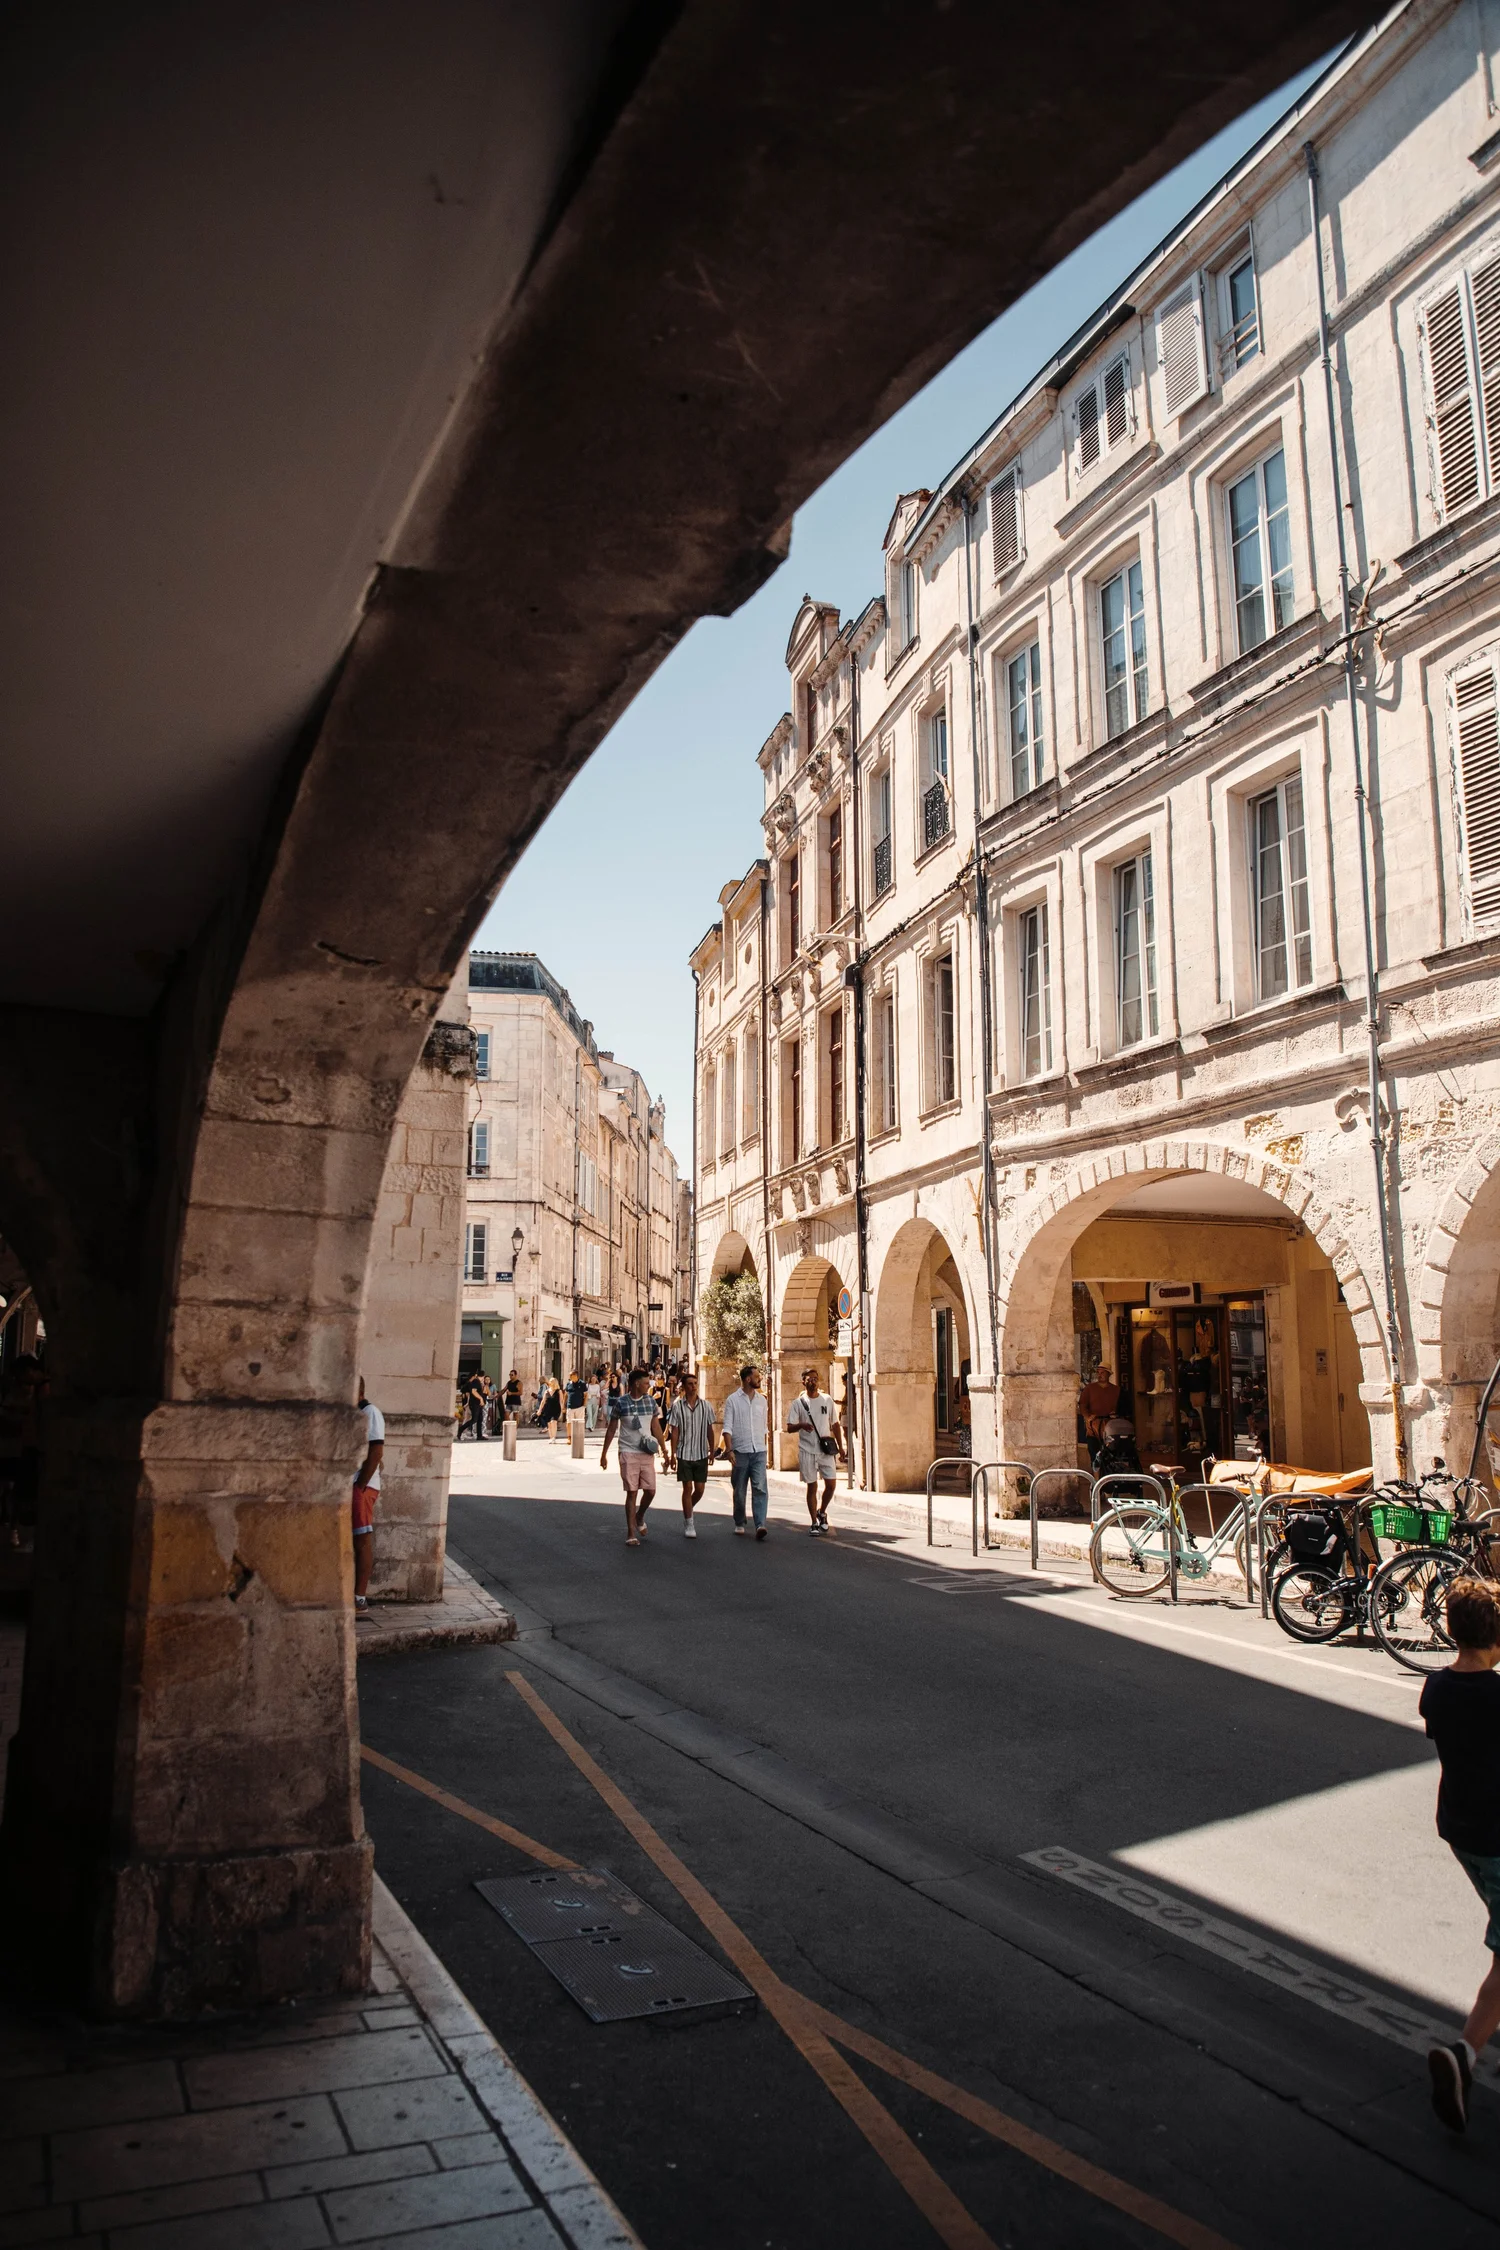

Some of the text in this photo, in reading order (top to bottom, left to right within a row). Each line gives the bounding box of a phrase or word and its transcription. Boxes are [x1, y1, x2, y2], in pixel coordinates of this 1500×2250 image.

[1120, 1316, 1128, 1364] CUIRS
[821, 1406, 828, 1415] N
[1040, 1850, 1488, 2045] VRAISONS
